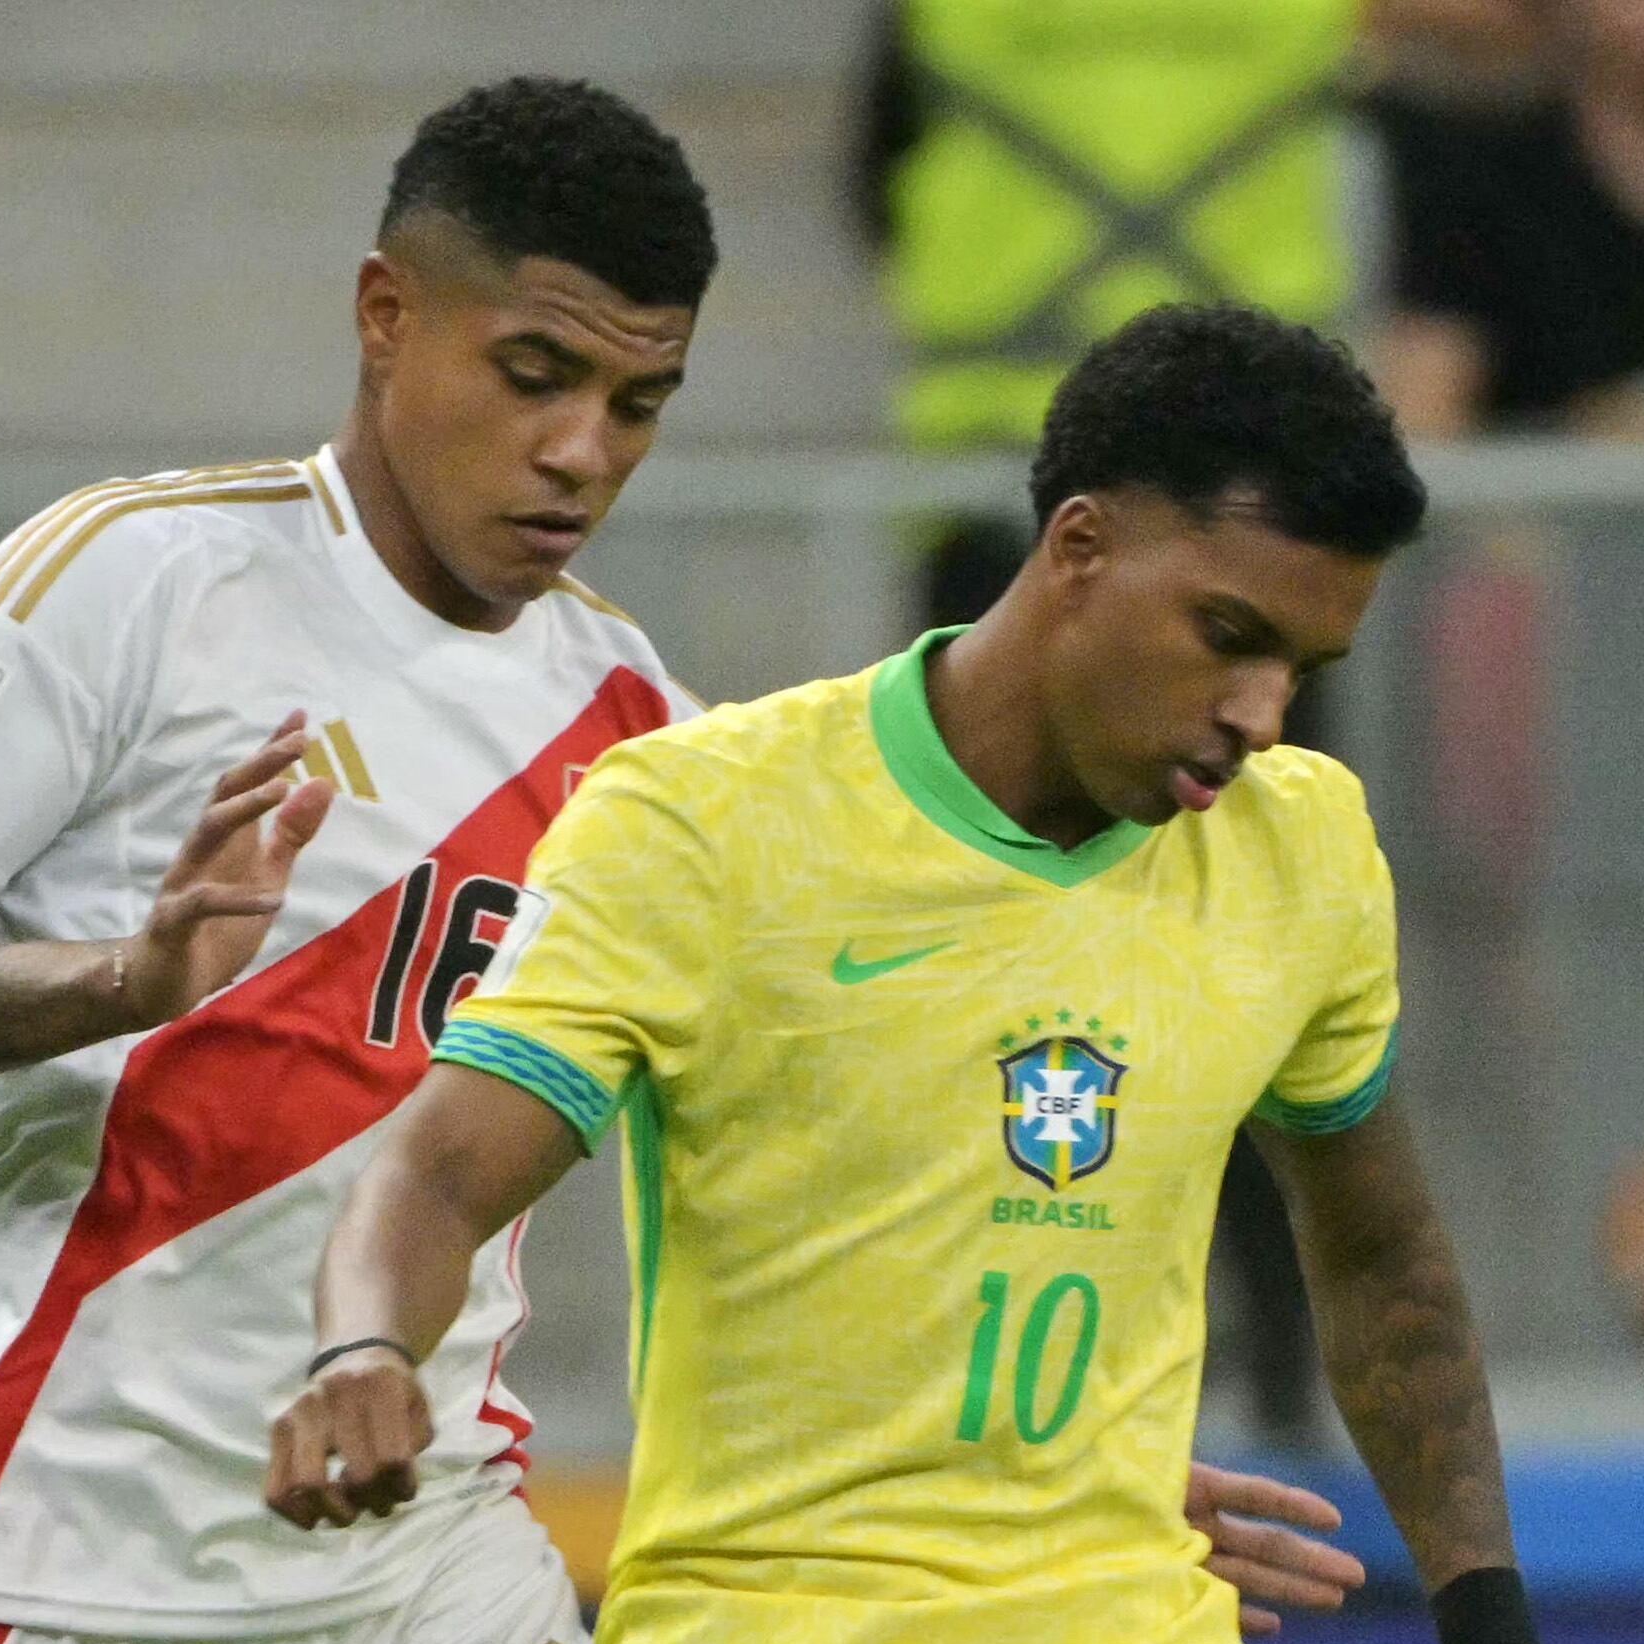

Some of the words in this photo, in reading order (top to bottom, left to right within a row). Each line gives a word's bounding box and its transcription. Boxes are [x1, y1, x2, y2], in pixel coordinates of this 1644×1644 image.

[364, 857, 521, 1055] 16
[1035, 1096, 1083, 1115] CBF
[991, 1197, 1116, 1230] BRASIL
[956, 1270, 1101, 1445] 10
